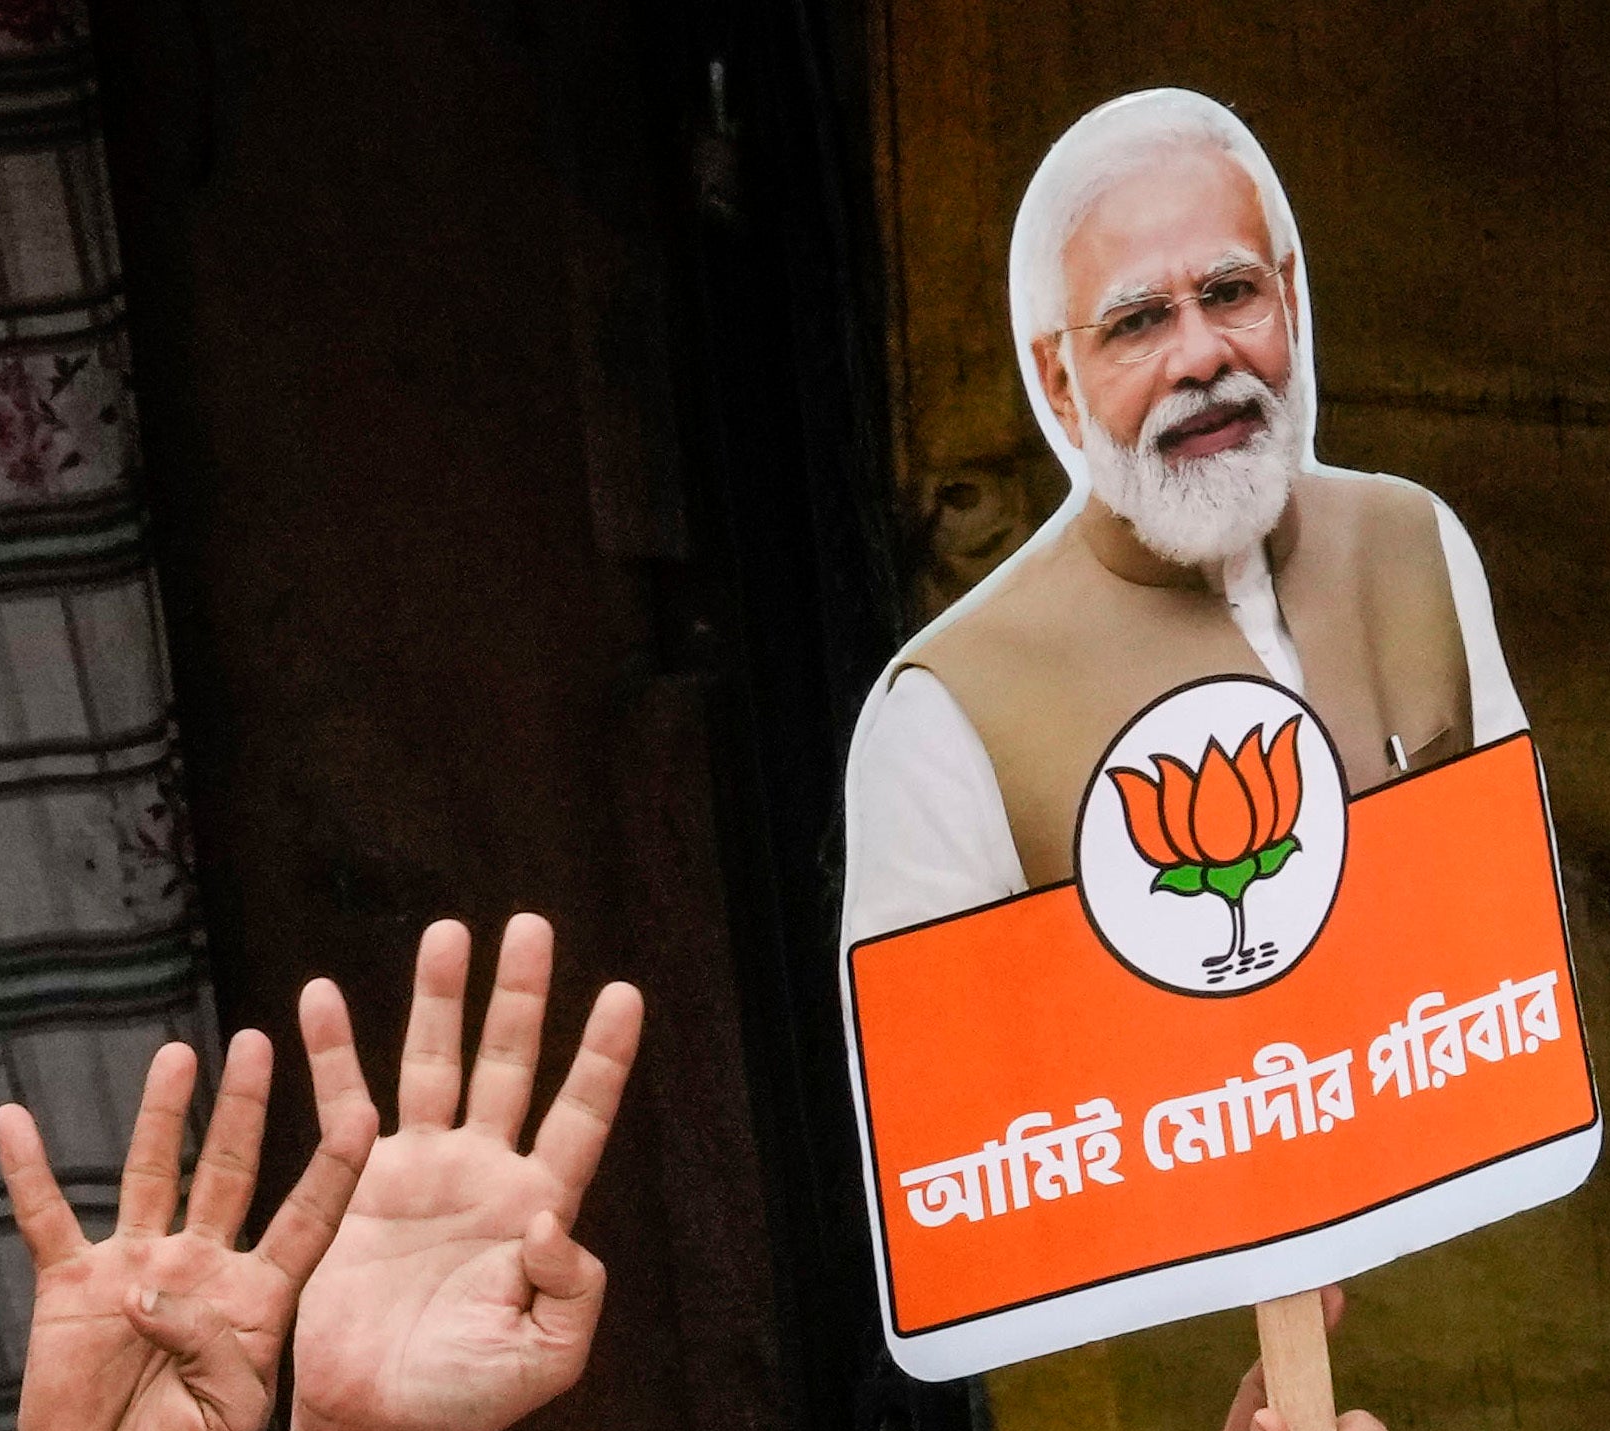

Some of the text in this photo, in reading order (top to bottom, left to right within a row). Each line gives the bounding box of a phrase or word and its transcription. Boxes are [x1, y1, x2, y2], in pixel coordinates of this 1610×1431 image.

[899, 970, 1562, 1228] আমিই মোদীর পরিবার
